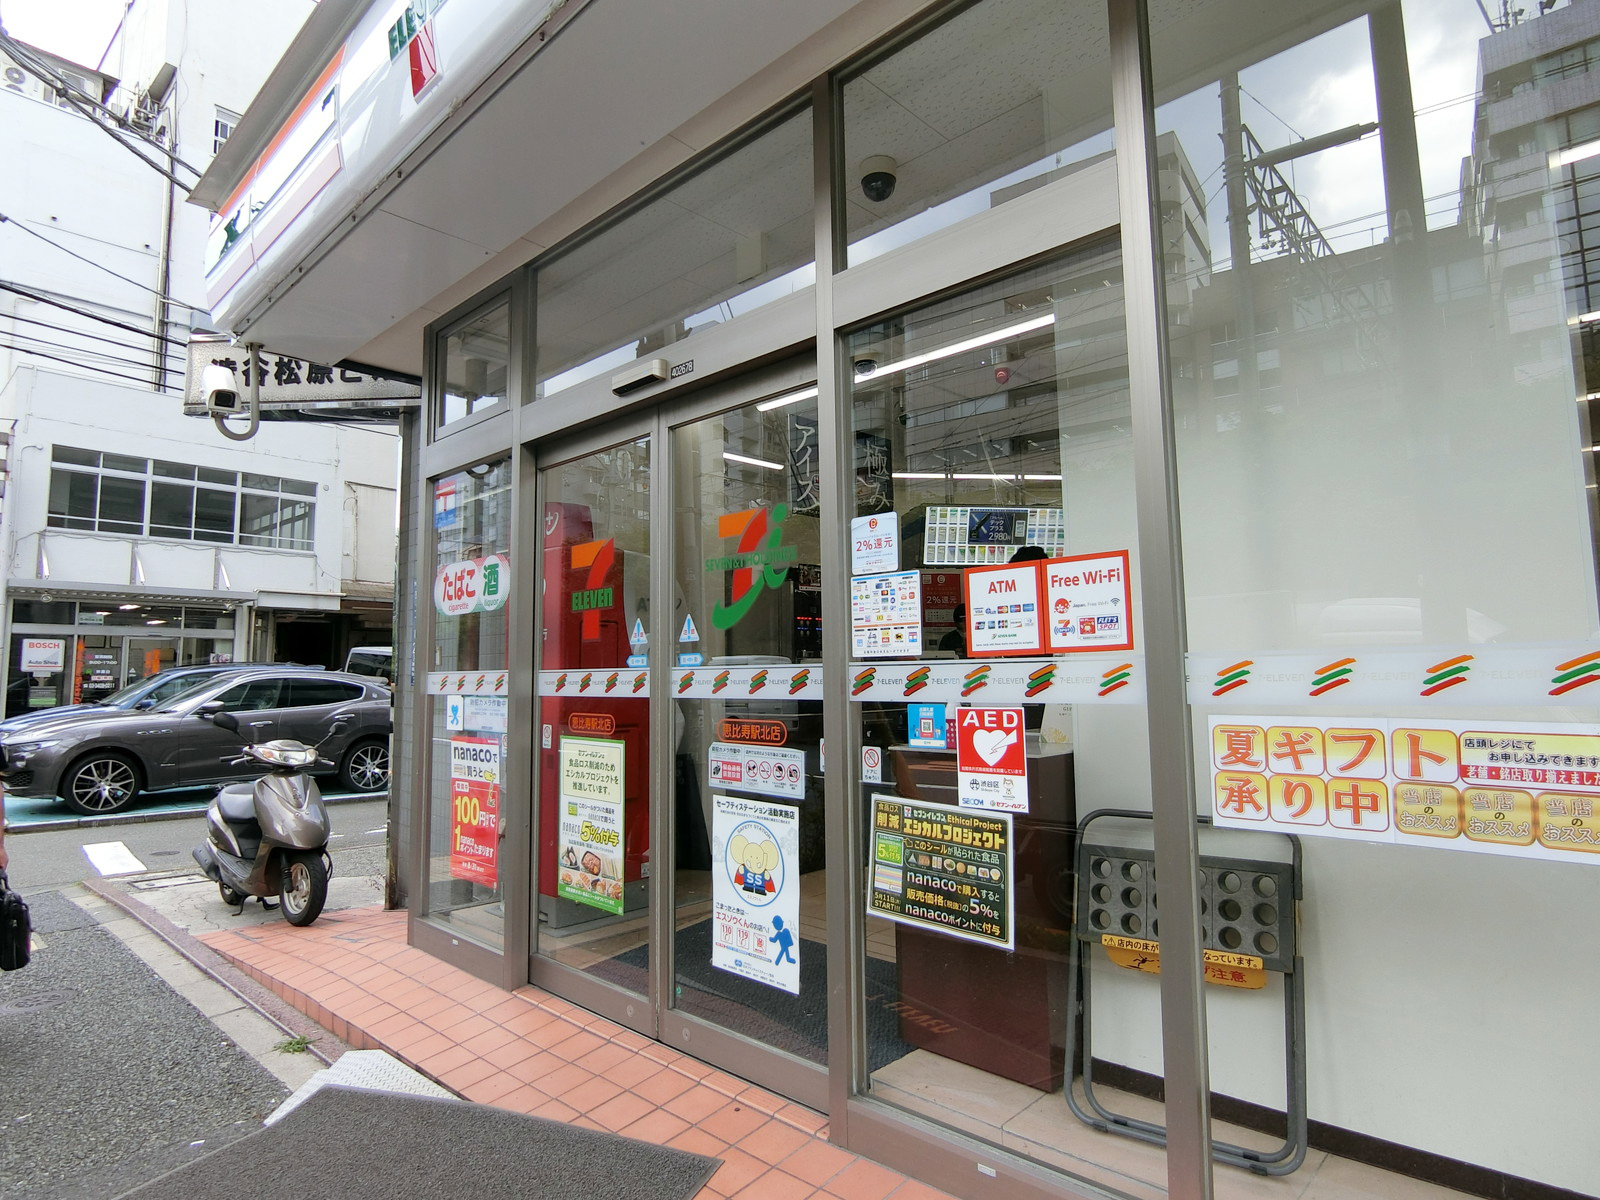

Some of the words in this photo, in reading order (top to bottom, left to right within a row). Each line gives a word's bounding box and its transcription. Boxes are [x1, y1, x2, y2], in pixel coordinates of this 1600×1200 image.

[856, 537, 893, 552] 2%還元
[443, 567, 476, 602] たばこ
[483, 563, 499, 596] 酒
[988, 579, 1017, 594] ATM
[1051, 574, 1080, 588] Free
[1082, 568, 1121, 585] Wi-Fi
[571, 716, 612, 732] 恵比寿駅北店
[962, 711, 1019, 728] AED
[722, 723, 781, 741] 恵比寿駅北店
[1219, 728, 1449, 778] 夏ギフト
[1464, 738, 1535, 751] 店頭レジにて
[453, 746, 498, 763] nanacoで
[467, 765, 483, 778] 買うと
[568, 758, 616, 773] 食品ロス削減のため
[566, 769, 619, 785] エシカルプロジェクトを
[962, 797, 984, 806] SECOM
[1221, 777, 1381, 826] 承り中
[1402, 788, 1442, 806] 当店
[1470, 792, 1514, 811] 当店
[878, 803, 899, 813] 食品ロス
[1424, 806, 1434, 815] の
[1494, 812, 1505, 820] の
[1546, 798, 1592, 818] 当店
[877, 812, 900, 829] 削減
[947, 814, 973, 827] Ethical
[973, 818, 1003, 831] Project
[1401, 812, 1456, 830] おススメ
[1469, 818, 1530, 837] おススメ
[1571, 818, 1583, 827] の
[903, 818, 1005, 850] エシカルプロジェクト
[914, 840, 1000, 865] このシールが貼られた食品
[746, 872, 763, 886] SS
[907, 871, 1000, 902] nanacoで購入すると
[905, 903, 1001, 936] nanacoポイントに付与
[721, 924, 732, 935] 110
[738, 930, 749, 940] 119
[1117, 938, 1159, 952] 店内の床が
